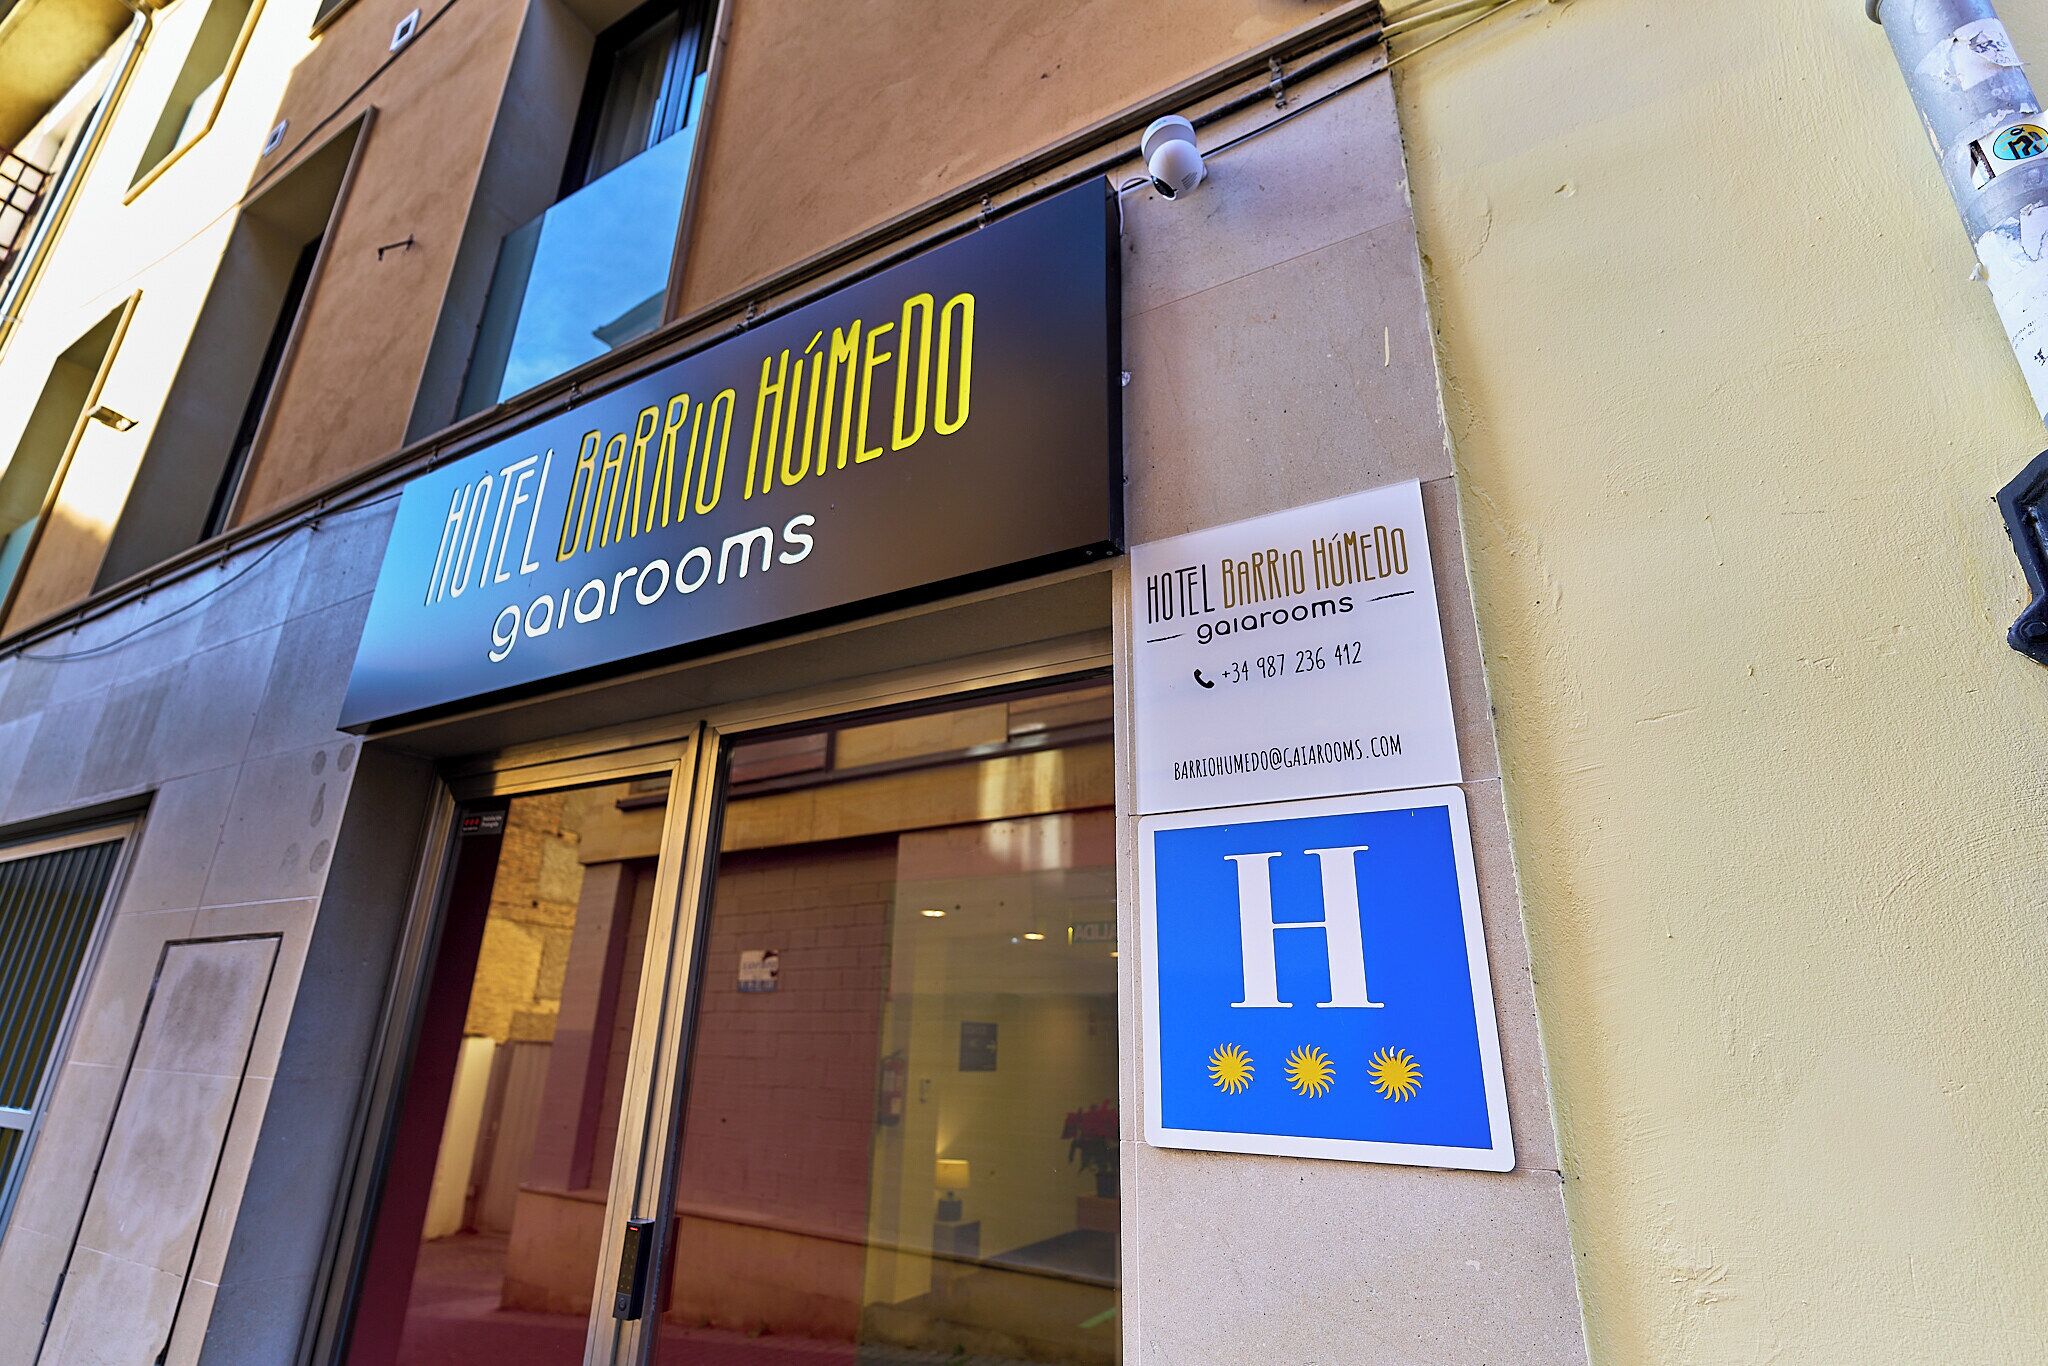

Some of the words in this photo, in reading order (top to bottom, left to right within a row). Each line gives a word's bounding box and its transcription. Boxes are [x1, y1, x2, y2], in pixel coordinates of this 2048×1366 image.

[424, 449, 556, 607] HOTEL
[556, 388, 735, 562] BARRIO
[743, 292, 976, 500] HÚMEDO
[489, 513, 816, 664] gaiarooms
[1147, 564, 1215, 624] HOTEL
[1221, 549, 1306, 609] BARRIO
[1312, 524, 1409, 591] HÚMEDO
[1196, 596, 1354, 644] gaiarooms
[1221, 661, 1249, 683] +34
[1256, 654, 1285, 679] 987
[1295, 647, 1326, 674] 236
[1334, 641, 1362, 666] 412
[1173, 734, 1403, 781] BARRIOHUMEDO@GAIAROOMS.COM
[1223, 845, 1385, 1009] H
